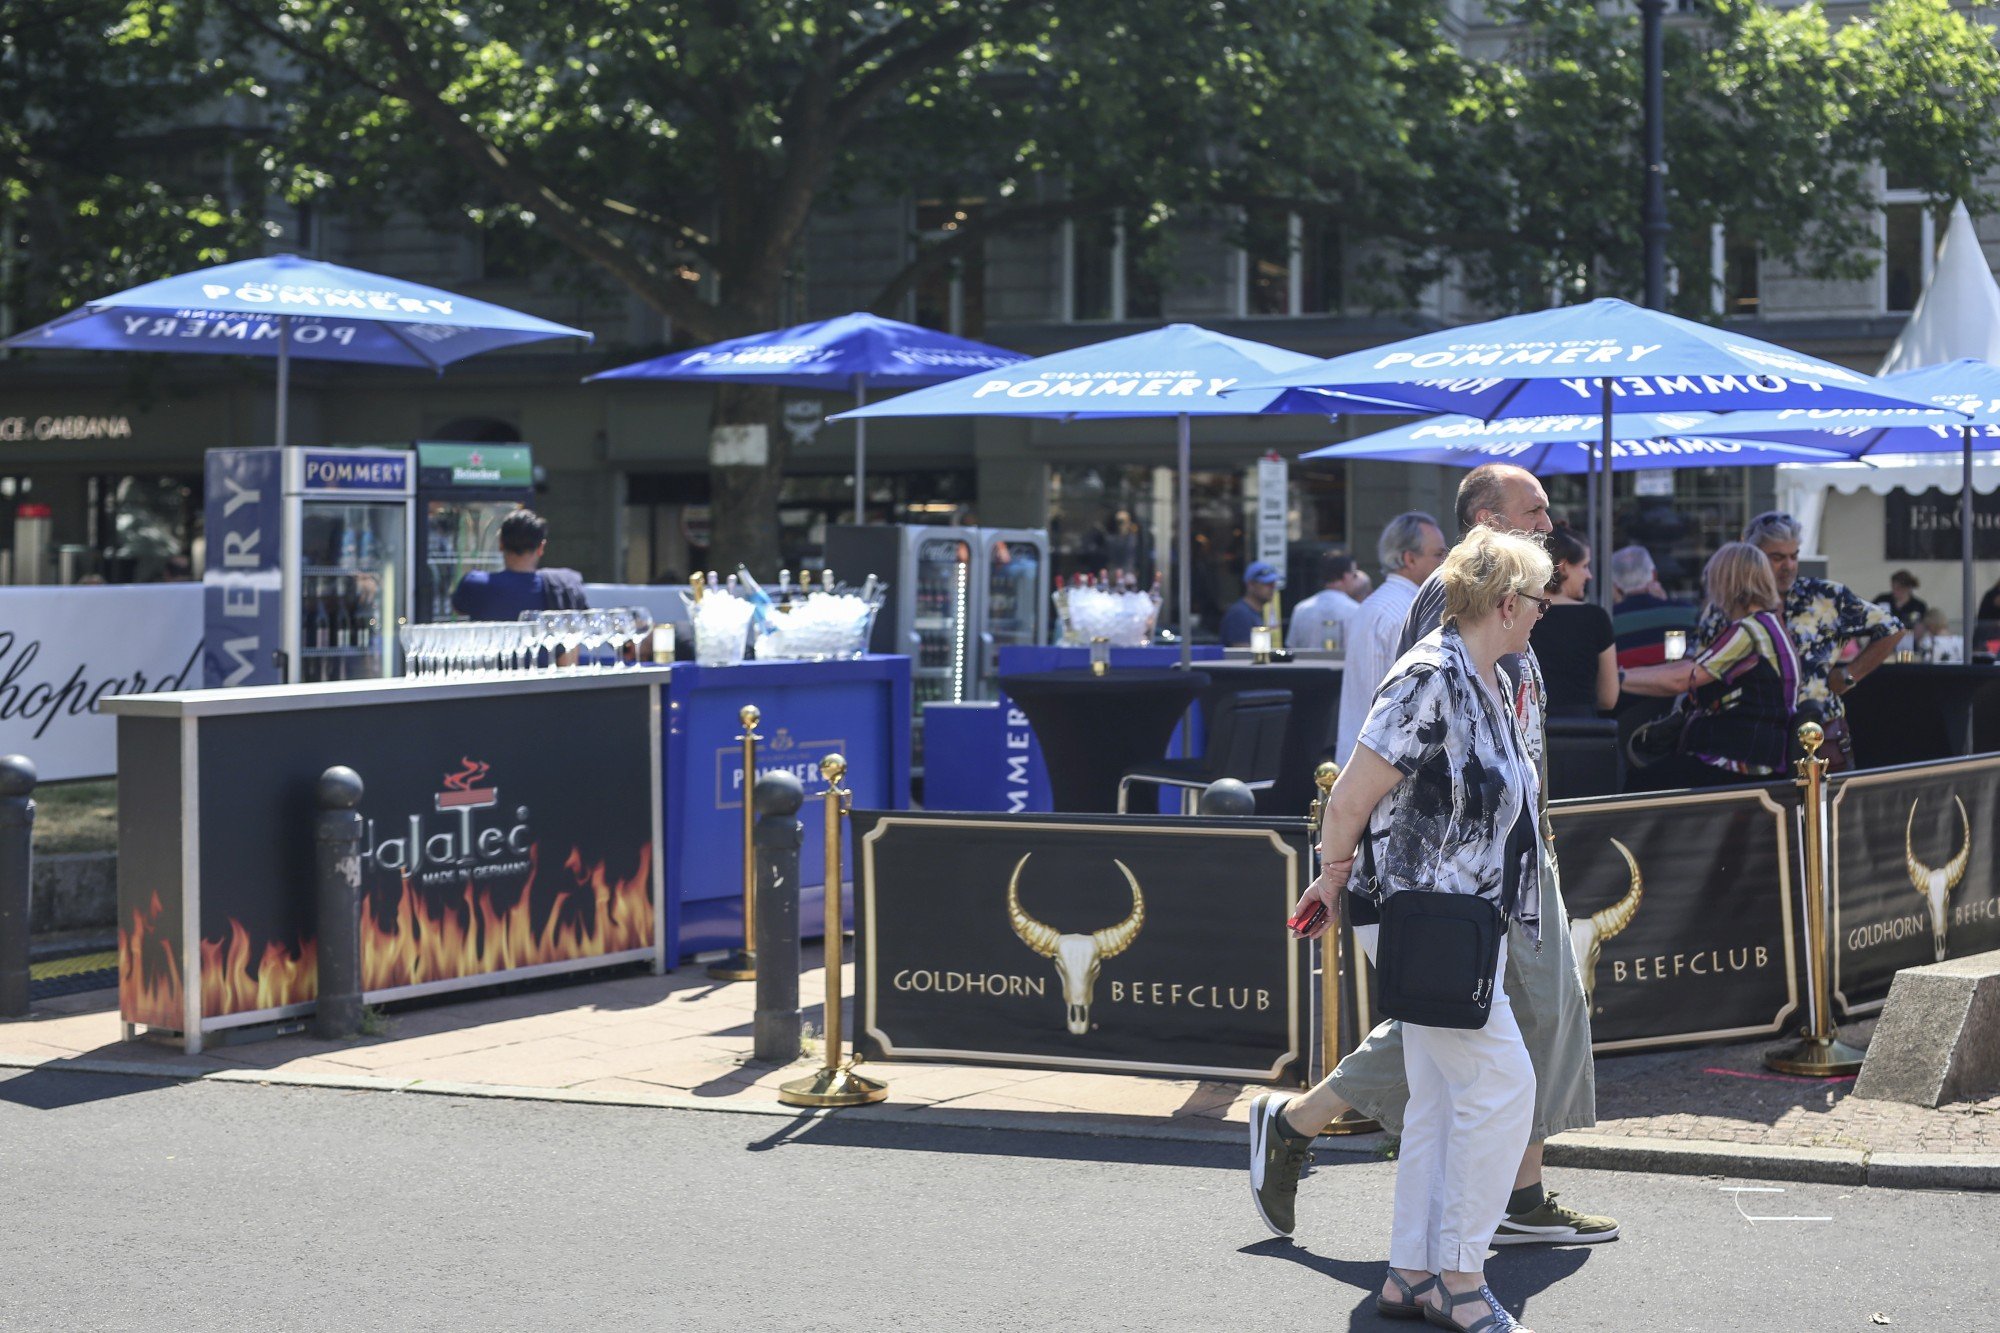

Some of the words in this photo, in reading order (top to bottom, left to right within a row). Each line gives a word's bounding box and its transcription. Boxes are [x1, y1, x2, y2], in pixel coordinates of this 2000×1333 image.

[202, 284, 454, 315] POMMERY
[1373, 344, 1664, 370] POMMERY
[972, 377, 1240, 399] POMMERY
[1040, 370, 1198, 380] CHAMPAGNE
[307, 461, 405, 483] POMMERY
[1007, 697, 1030, 814] MMER
[1848, 914, 1923, 951] GOLDHORN
[1955, 898, 2000, 927] BEEFC
[1613, 946, 1769, 983] BEEFCLUB
[893, 969, 1046, 997] GOLDHORN
[1111, 981, 1271, 1011] BEEFCLUB
